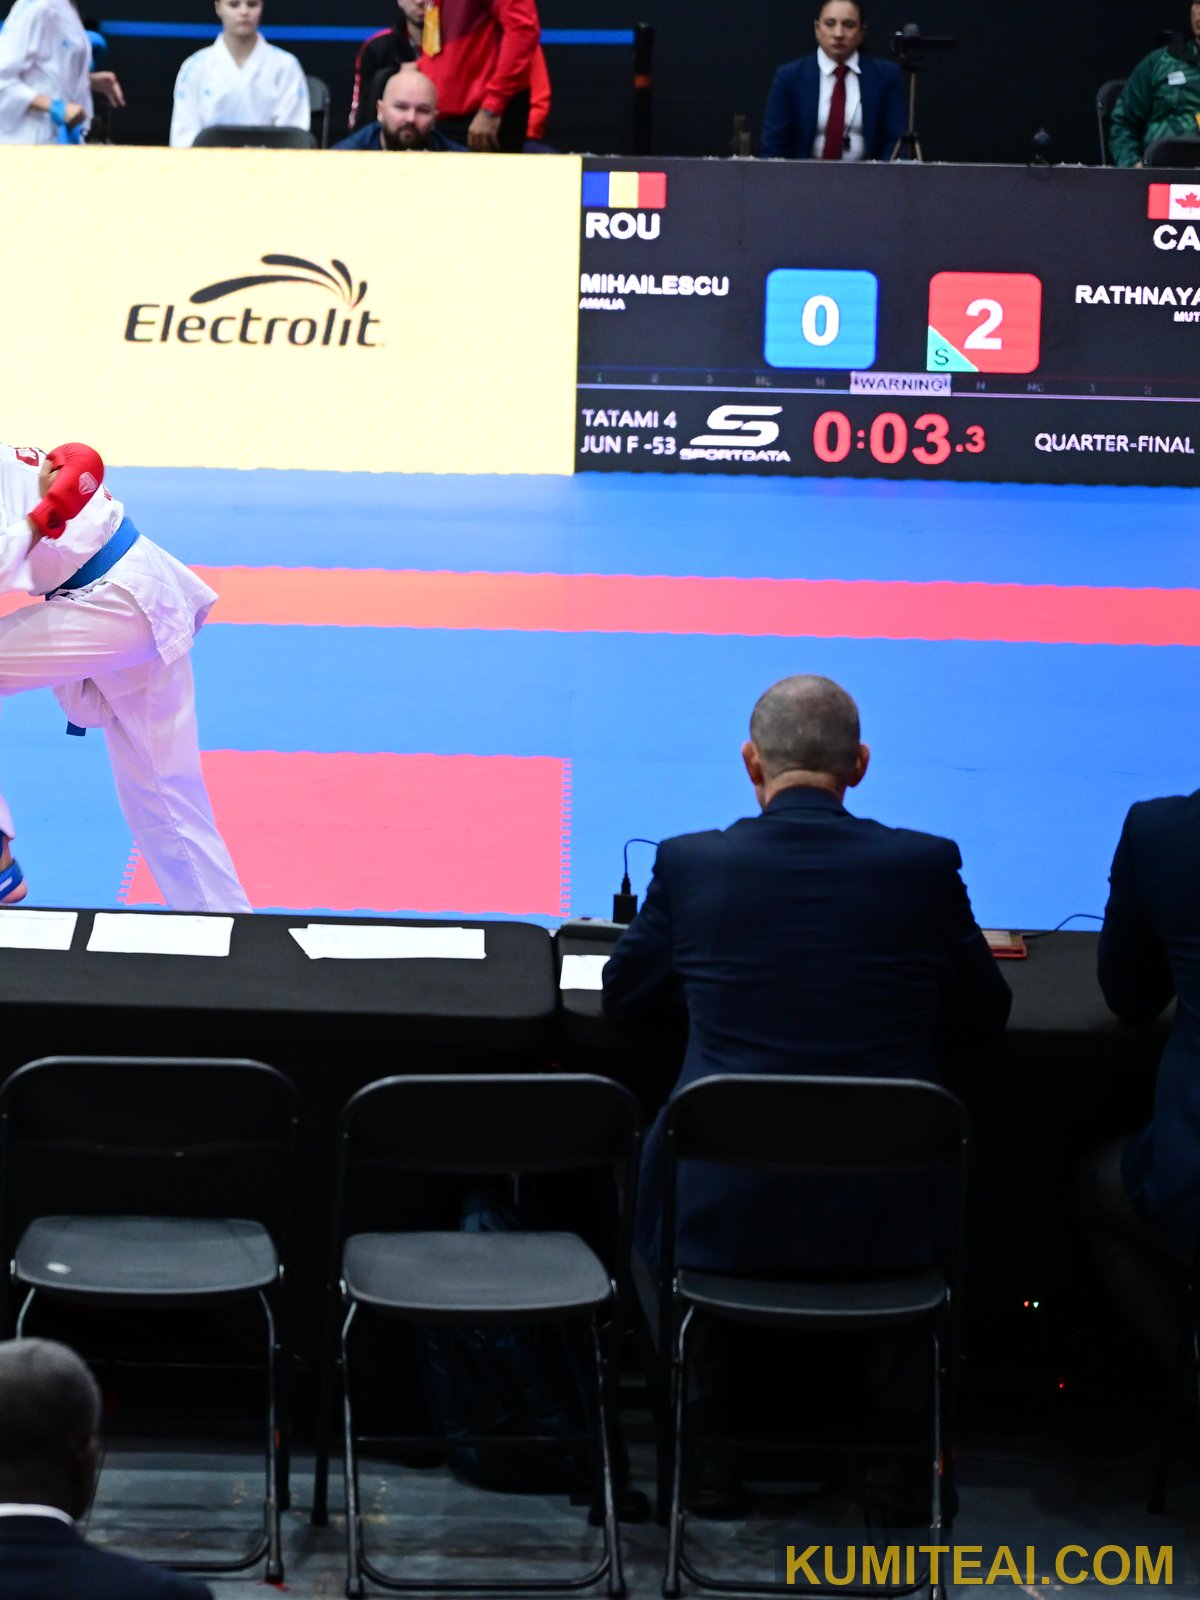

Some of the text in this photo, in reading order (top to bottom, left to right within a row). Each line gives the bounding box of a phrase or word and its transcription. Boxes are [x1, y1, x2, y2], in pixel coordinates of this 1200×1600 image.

[585, 211, 661, 240] ROU
[1153, 224, 1200, 251] CA
[580, 273, 730, 296] MIHAILESCU
[124, 303, 382, 347] Electrolit
[802, 295, 840, 346] 0
[963, 298, 1003, 350] 2
[934, 348, 949, 366] S
[581, 408, 677, 428] TATAMI 4
[580, 434, 677, 455] JUN F -53
[1034, 432, 1195, 454] QUARTER-FINAL
[679, 448, 791, 462] SPORTDATA
